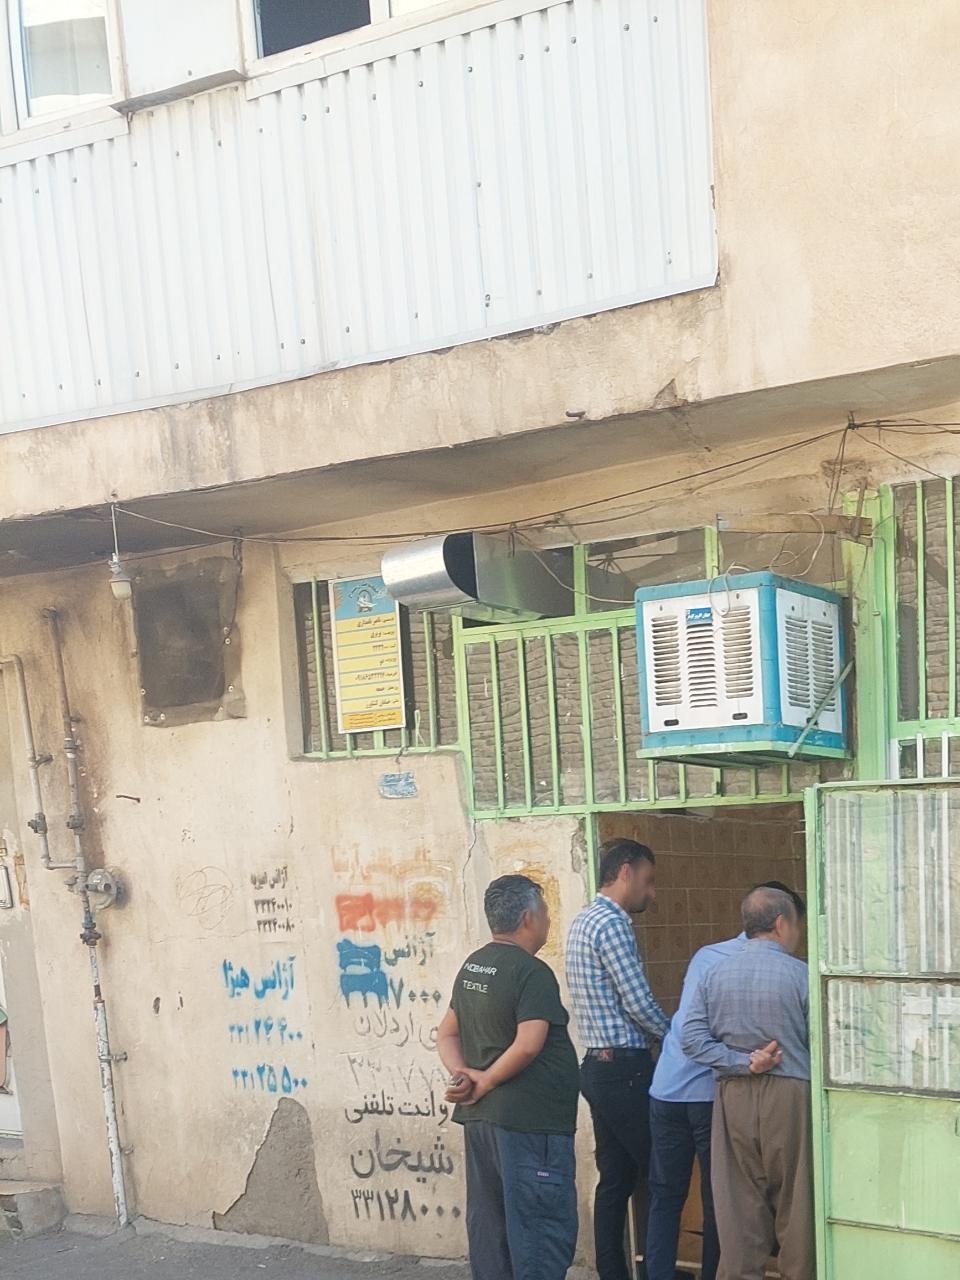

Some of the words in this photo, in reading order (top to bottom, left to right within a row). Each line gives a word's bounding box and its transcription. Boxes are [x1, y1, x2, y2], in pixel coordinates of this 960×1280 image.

[254, 953, 297, 1001] آژانس
[462, 979, 489, 994] TEXTILE
[344, 1088, 394, 1124] تلفنی
[350, 1128, 455, 1184] شیخان
[350, 1187, 462, 1222] ۳۳۱۲۸۰۰۰
